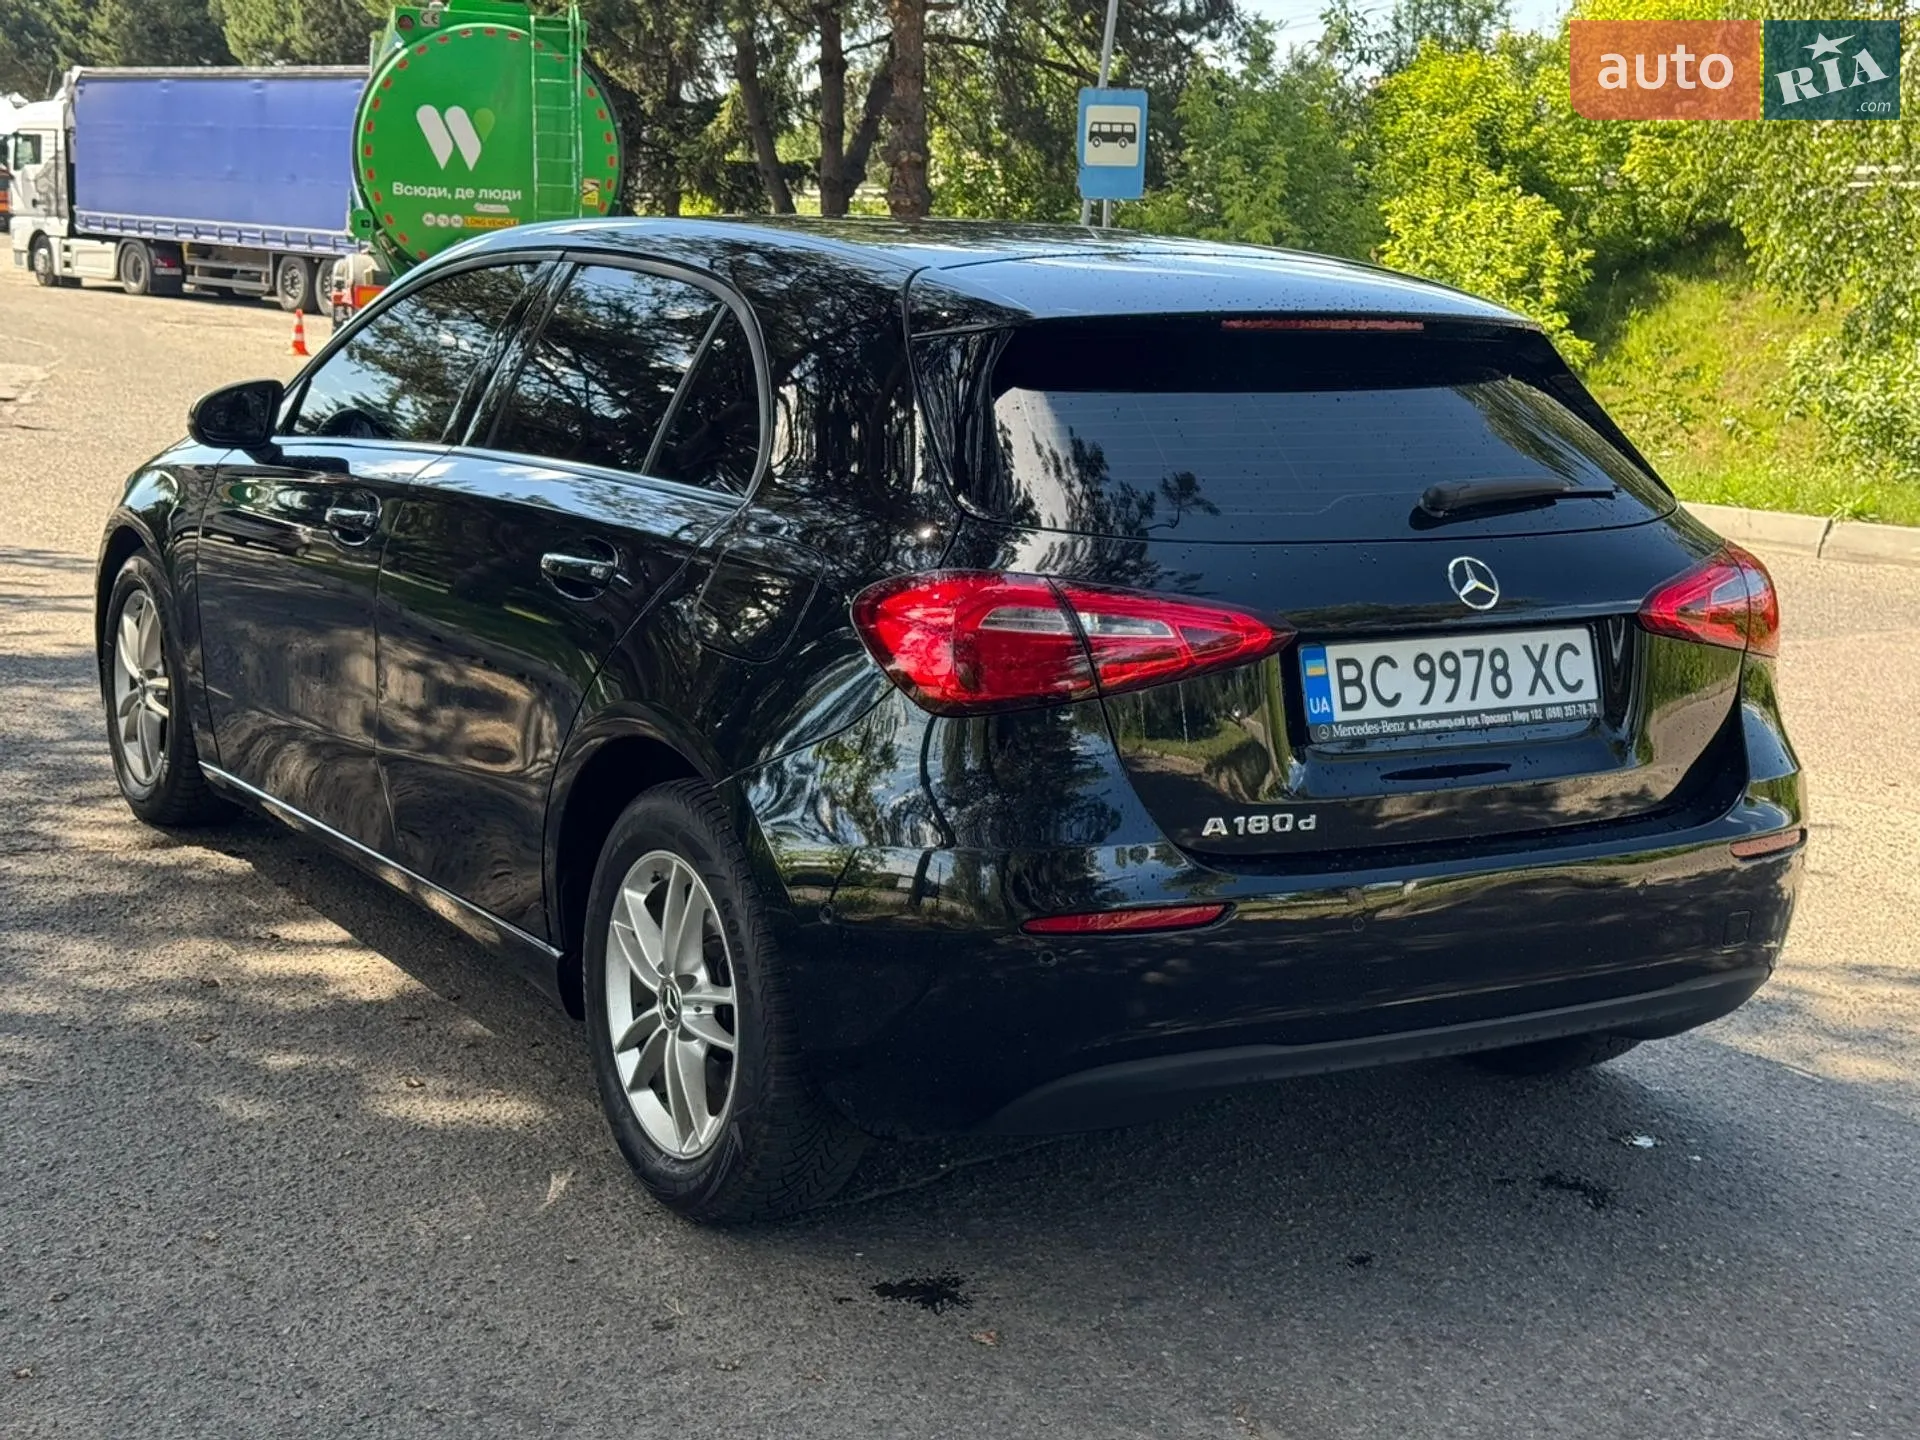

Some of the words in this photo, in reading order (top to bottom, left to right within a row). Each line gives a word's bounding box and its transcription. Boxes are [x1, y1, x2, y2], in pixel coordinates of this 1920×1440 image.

[392, 182, 452, 199] Всюди,
[454, 188, 475, 199] де
[478, 188, 522, 201] люди
[1336, 654, 1402, 712] BC
[1413, 648, 1513, 706] 9978
[1522, 642, 1585, 697] XC
[1309, 696, 1331, 714] UA
[1332, 720, 1406, 737] Mercedes-Benz
